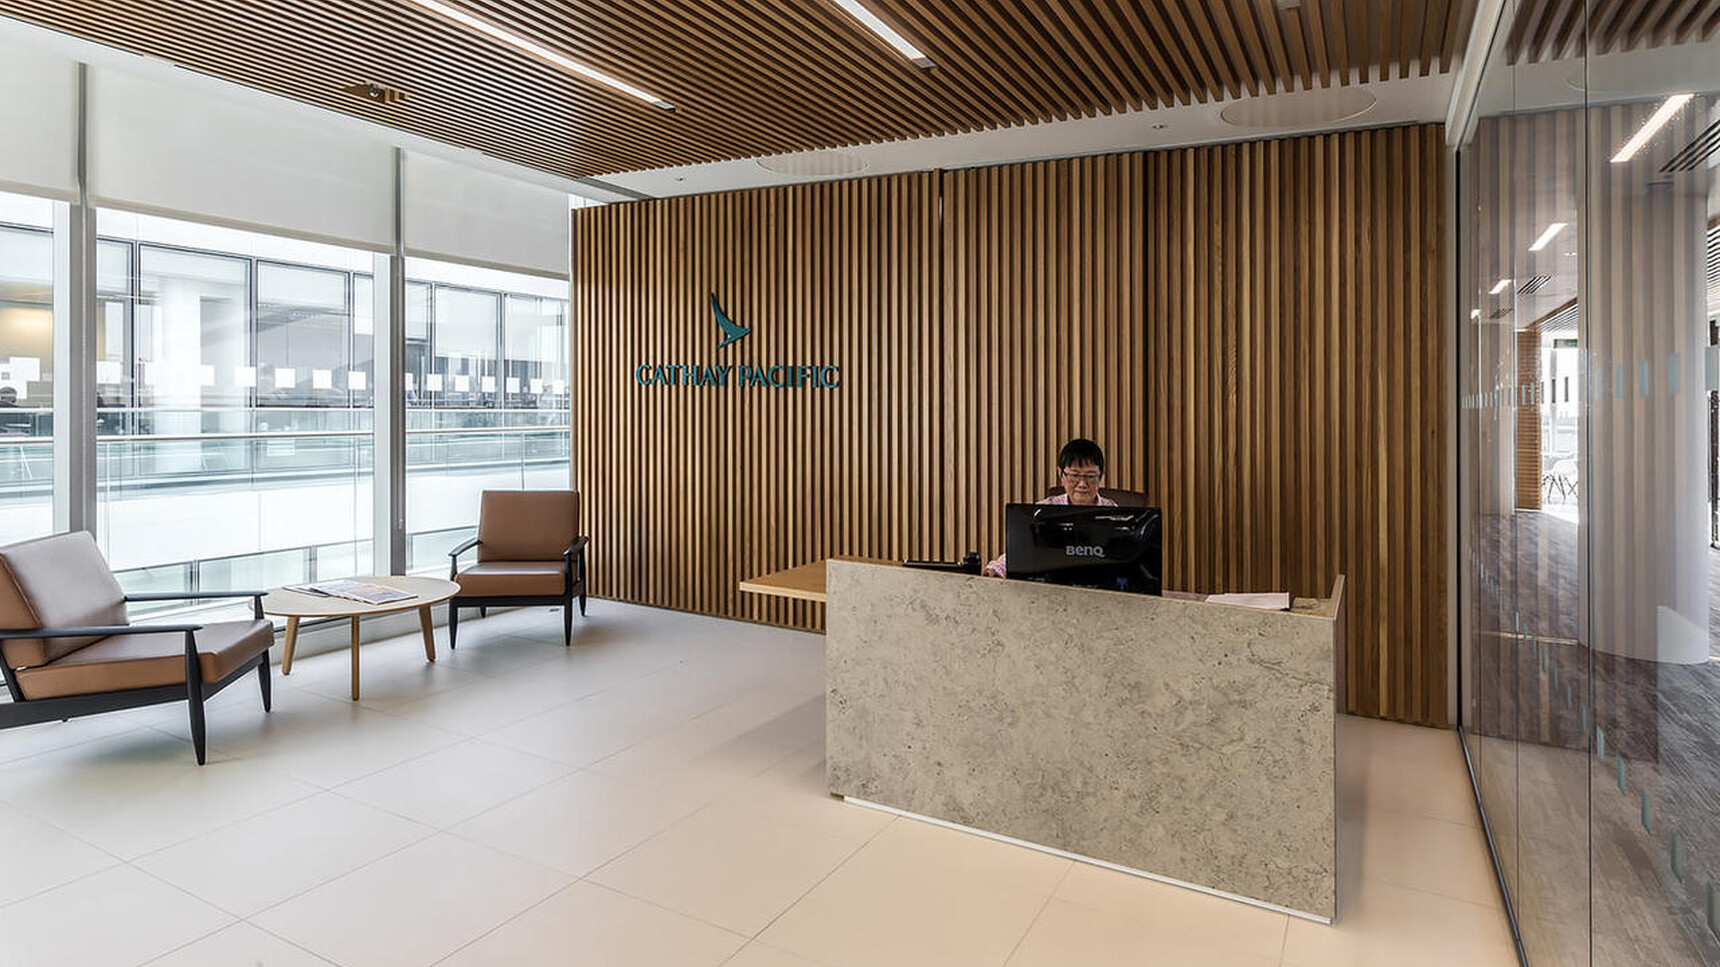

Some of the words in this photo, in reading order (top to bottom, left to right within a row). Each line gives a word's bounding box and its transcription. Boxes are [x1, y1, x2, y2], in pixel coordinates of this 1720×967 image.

[636, 364, 732, 387] CATHAY
[738, 365, 840, 388] PACIFIC
[1066, 545, 1105, 557] BenQ
